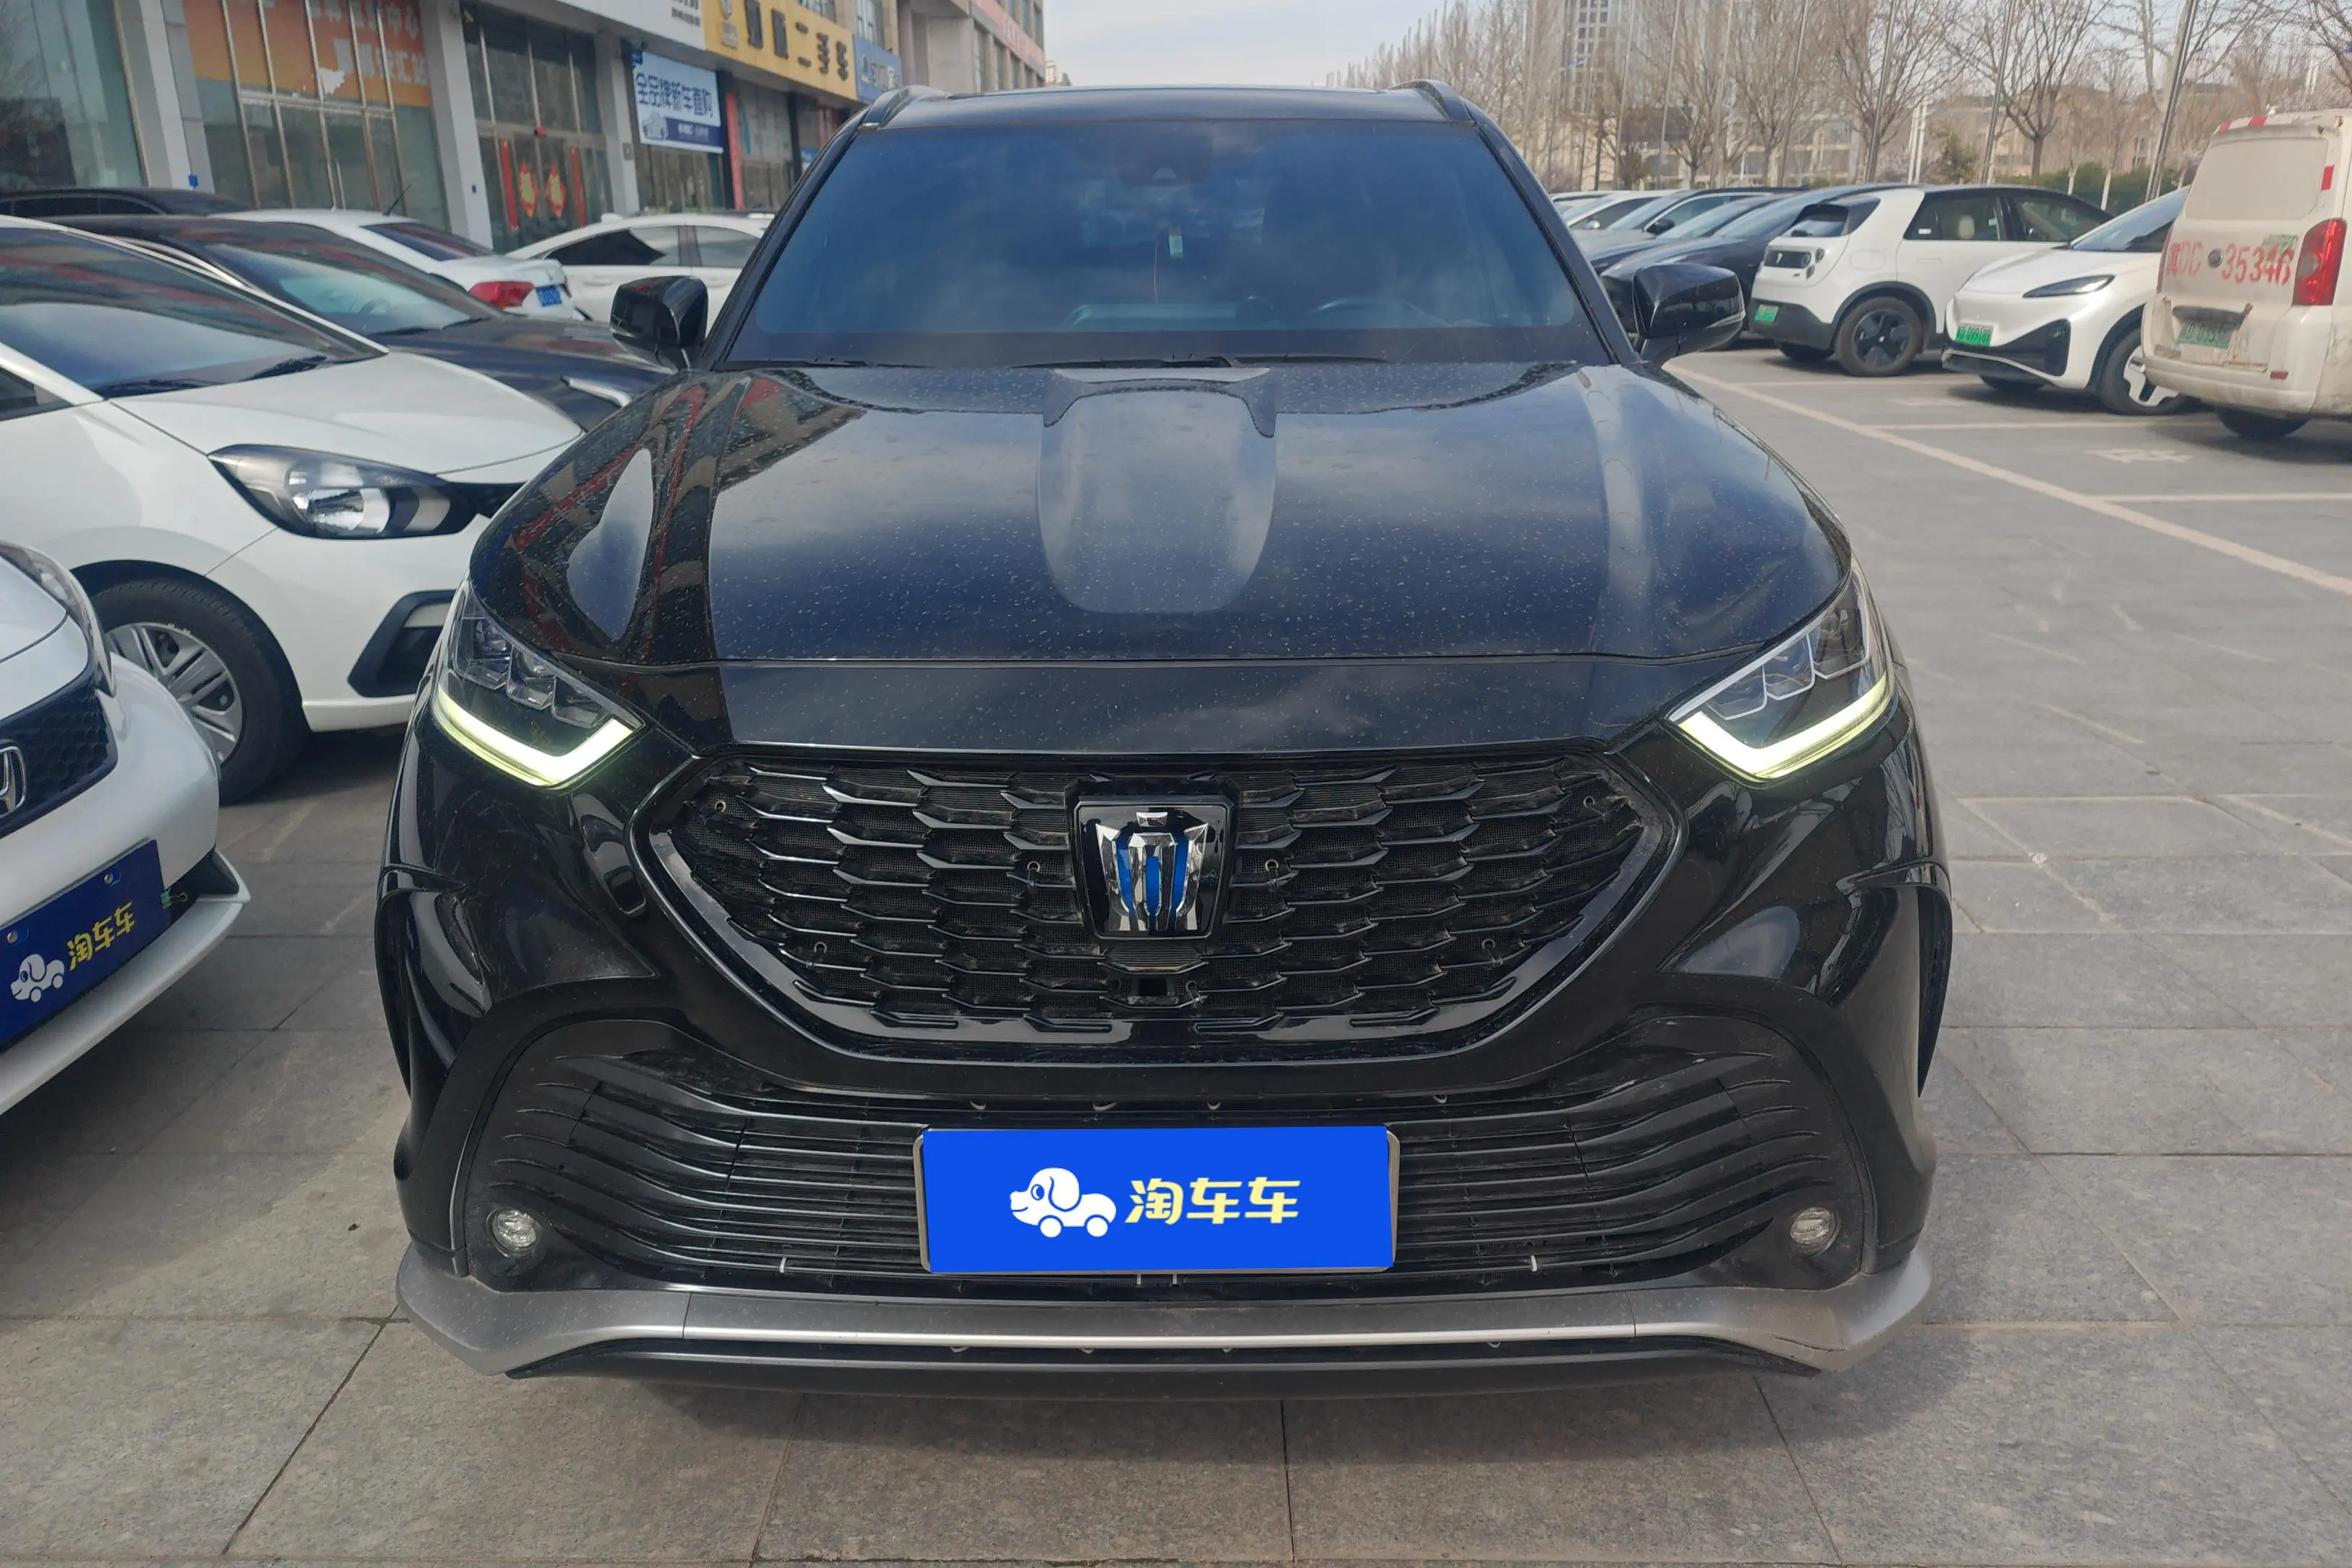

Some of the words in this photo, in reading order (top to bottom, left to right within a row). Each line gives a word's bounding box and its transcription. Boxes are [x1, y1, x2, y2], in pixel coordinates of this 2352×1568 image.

[635, 72, 714, 118] 全品牌新车直购
[67, 901, 135, 972] 淘车车
